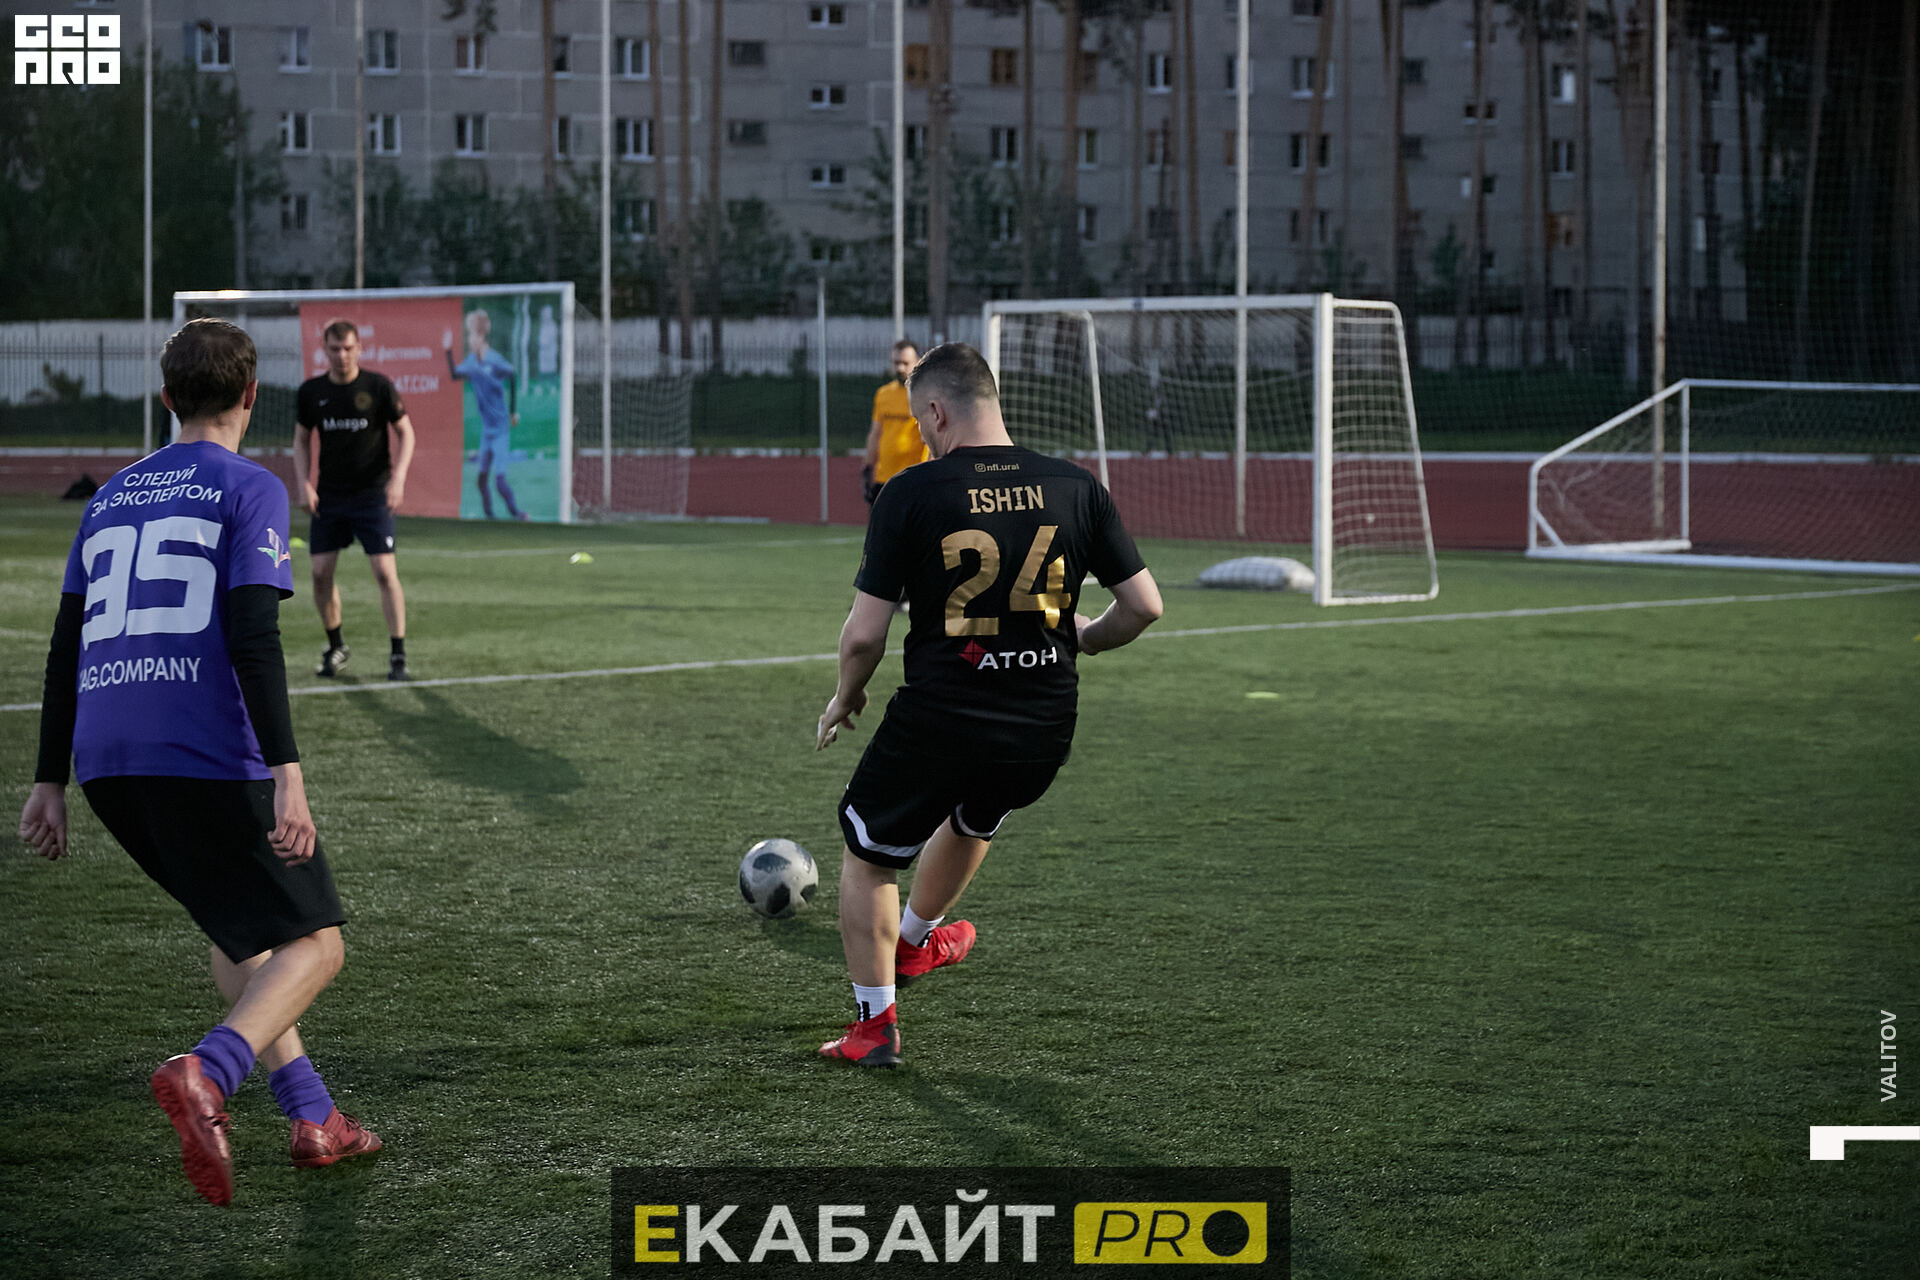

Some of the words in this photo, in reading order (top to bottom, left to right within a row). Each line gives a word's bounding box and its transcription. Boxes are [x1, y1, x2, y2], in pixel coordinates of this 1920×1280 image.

[123, 464, 198, 487] СЛЕДУЙ
[91, 500, 108, 518] ЗА
[110, 484, 223, 508] ЭКСПЕРТОМ
[967, 485, 1045, 514] ISHIN
[81, 516, 223, 651] 95
[941, 525, 1072, 637] 24
[79, 657, 201, 693] AG.COMPANY
[977, 647, 1058, 670] АТОН
